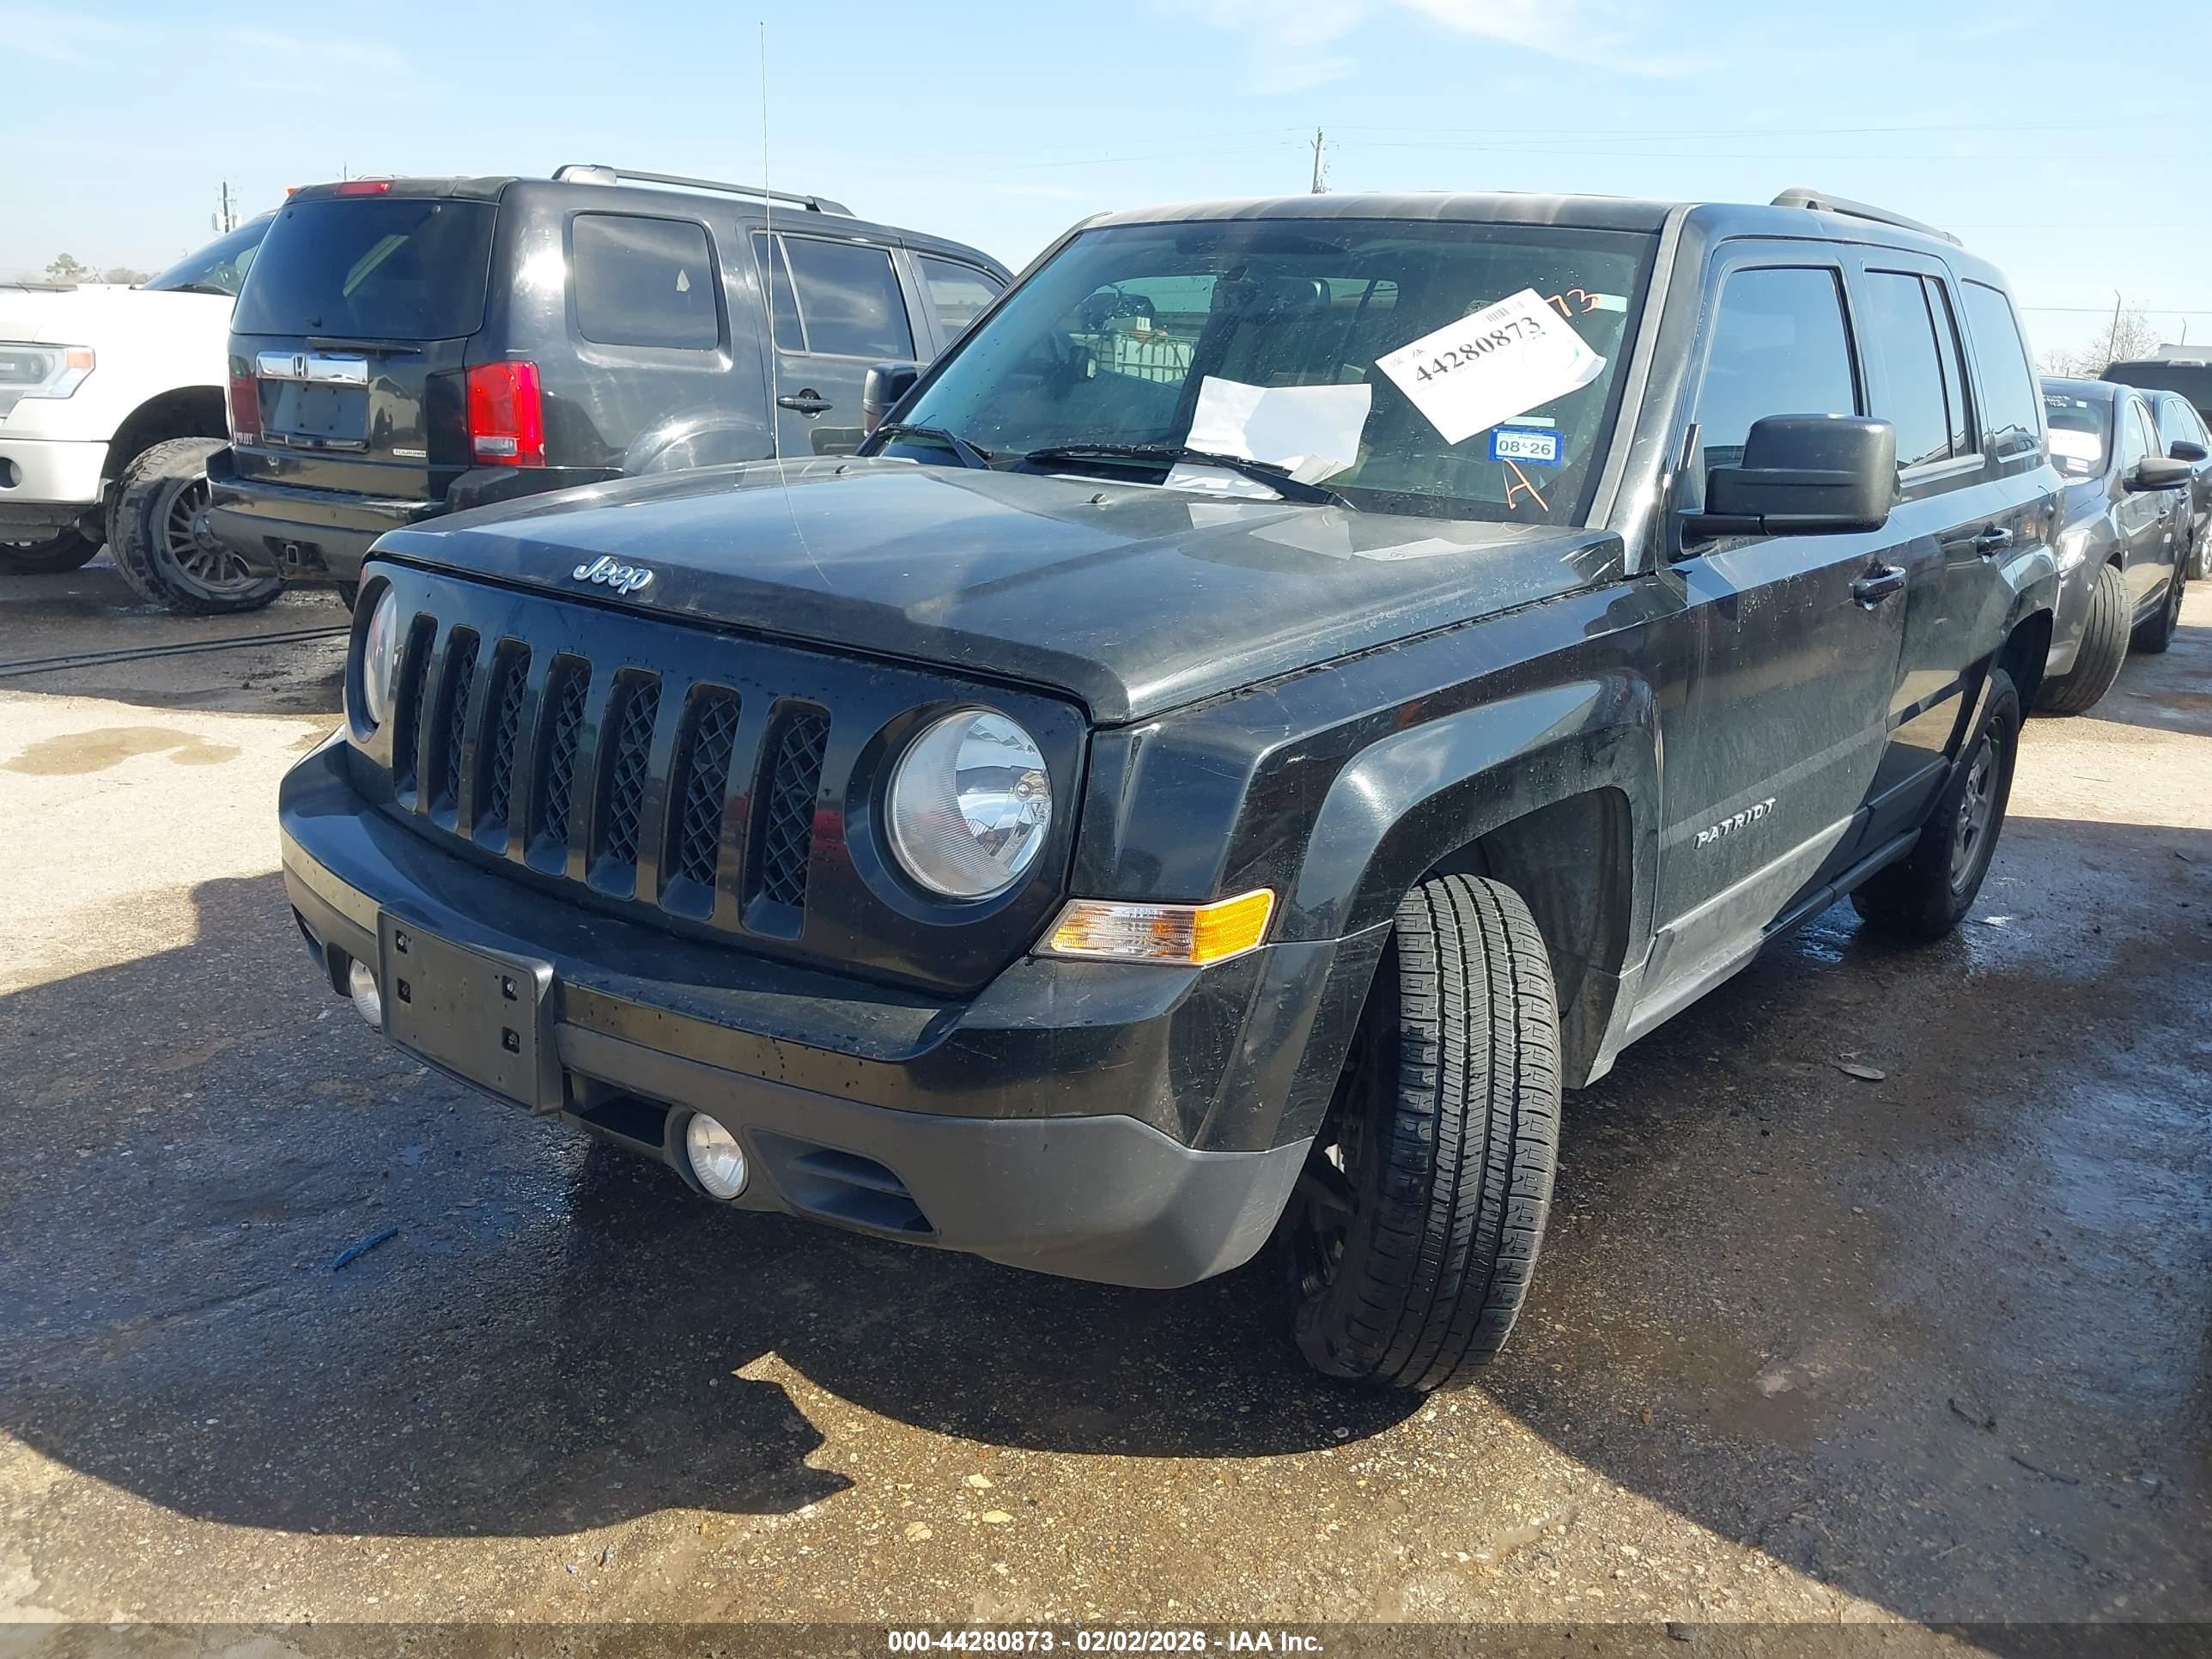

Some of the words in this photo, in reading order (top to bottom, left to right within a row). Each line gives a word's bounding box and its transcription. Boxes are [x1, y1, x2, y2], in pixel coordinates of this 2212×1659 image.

[1415, 316, 1542, 383] 44280873
[1498, 440, 1521, 453] 08
[1529, 442, 1552, 456] 26
[573, 555, 653, 596] Jeep
[1693, 797, 1777, 849] PATRIOT
